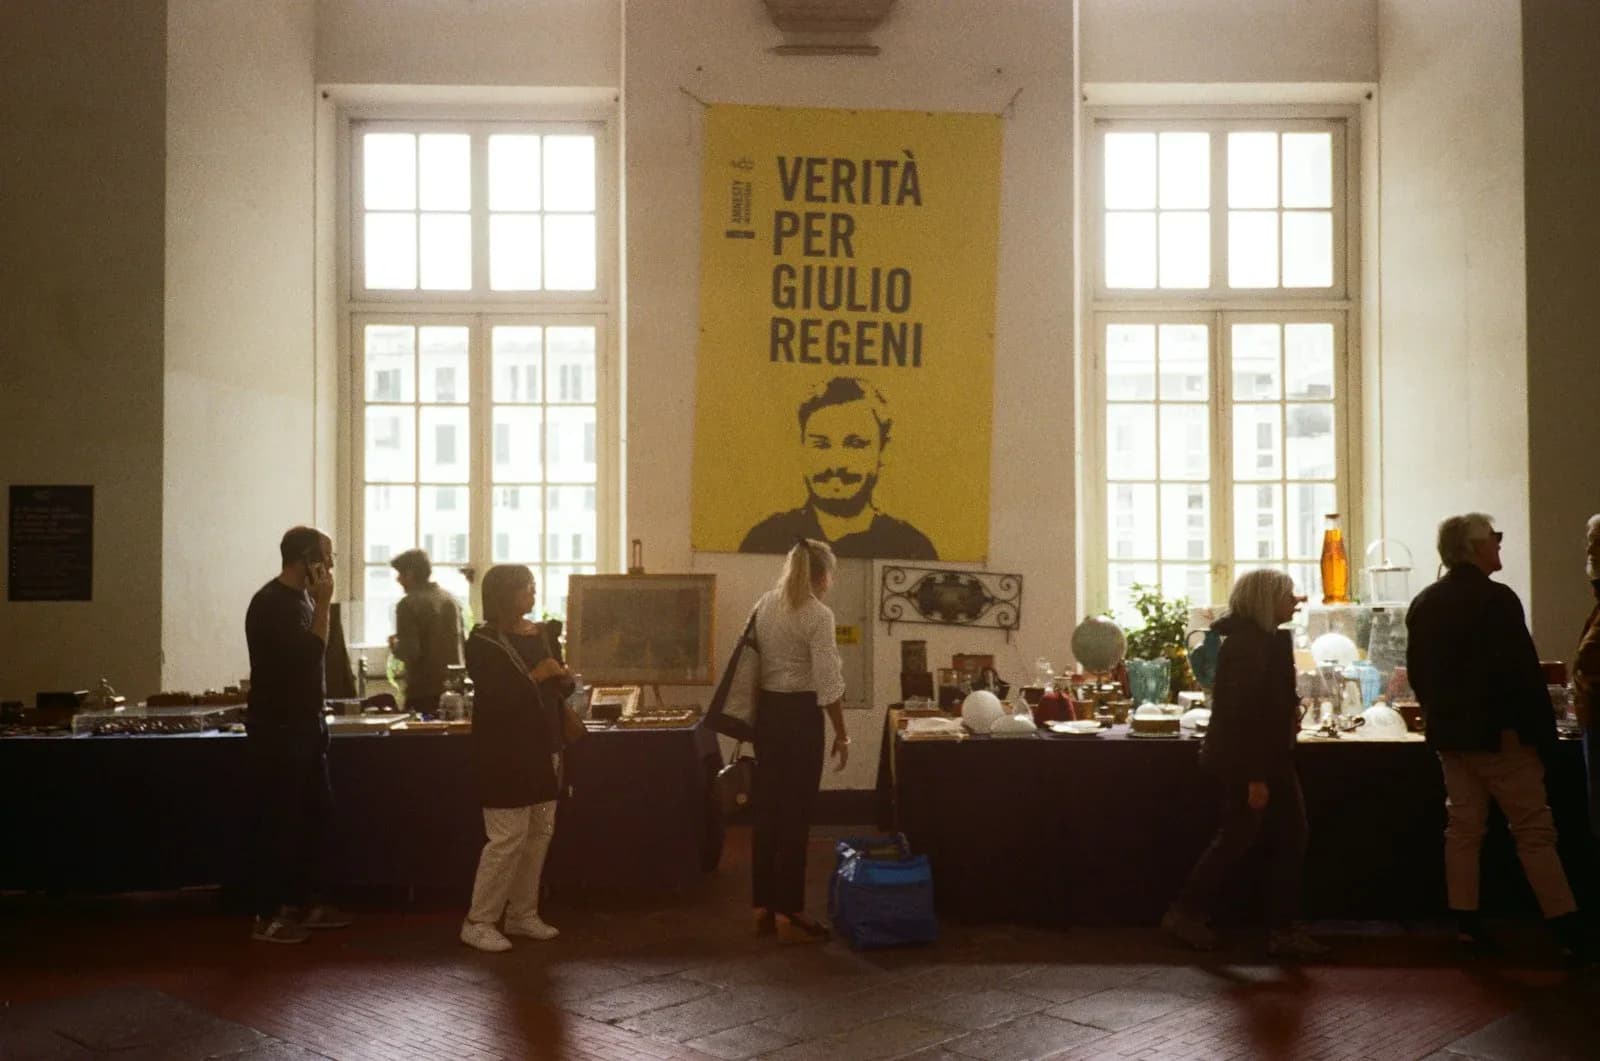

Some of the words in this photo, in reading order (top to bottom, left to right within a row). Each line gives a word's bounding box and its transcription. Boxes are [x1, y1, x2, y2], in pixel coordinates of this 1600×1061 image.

[731, 180, 744, 224] AMNESTY
[776, 149, 922, 206] VERITÀ
[773, 210, 855, 258] PER
[772, 264, 912, 313] GIULIO
[770, 316, 922, 368] REGENI
